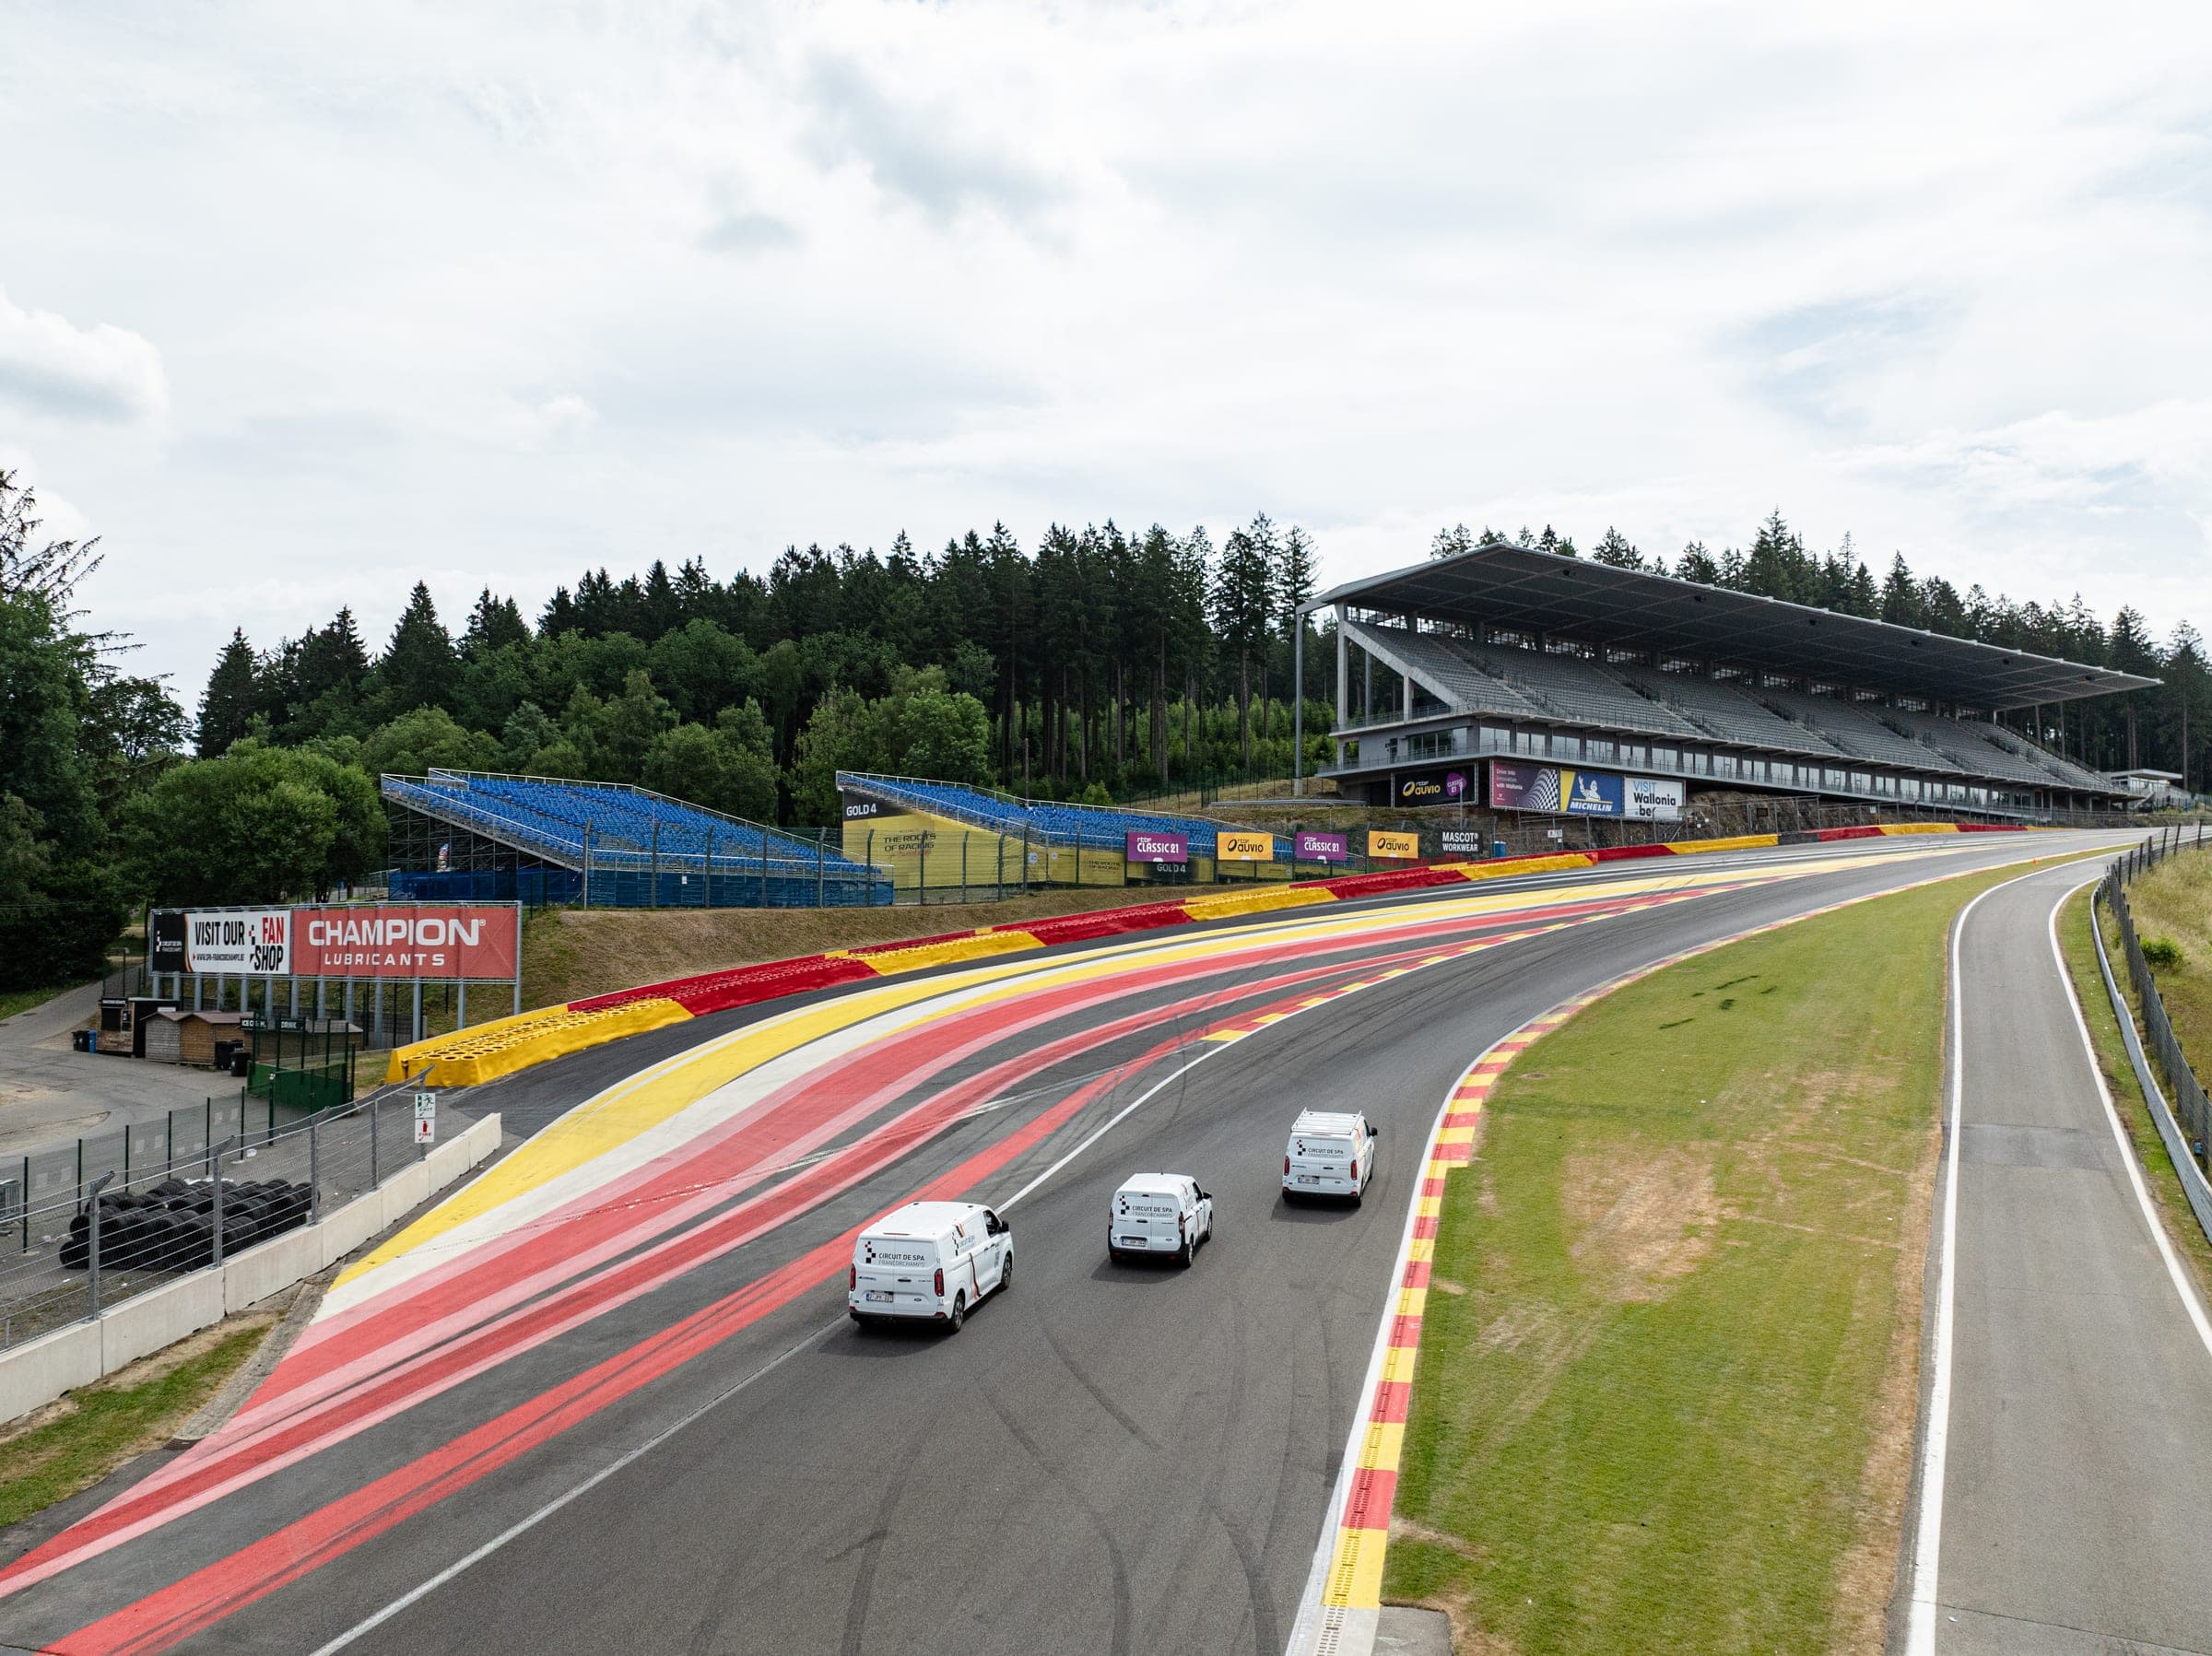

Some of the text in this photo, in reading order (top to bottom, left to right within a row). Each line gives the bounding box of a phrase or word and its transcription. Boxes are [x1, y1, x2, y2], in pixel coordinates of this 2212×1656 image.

[1633, 781, 1657, 792] VISIT
[1634, 792, 1676, 806] Wallonia
[846, 803, 877, 816] GOLD 4
[1570, 801, 1612, 812] MICHELIN
[1137, 842, 1179, 854] CLASSIC 21
[1237, 843, 1264, 853] auvio
[1304, 841, 1339, 852] CLASSIC 21
[1386, 842, 1410, 851] auvio
[1442, 843, 1478, 852] WORKWEAR
[1157, 863, 1186, 873] GOLD 4
[195, 921, 245, 945] VISIT OUR
[262, 916, 284, 944] FAN
[254, 945, 283, 971] SHOP
[324, 953, 445, 966] LUBRICANTS
